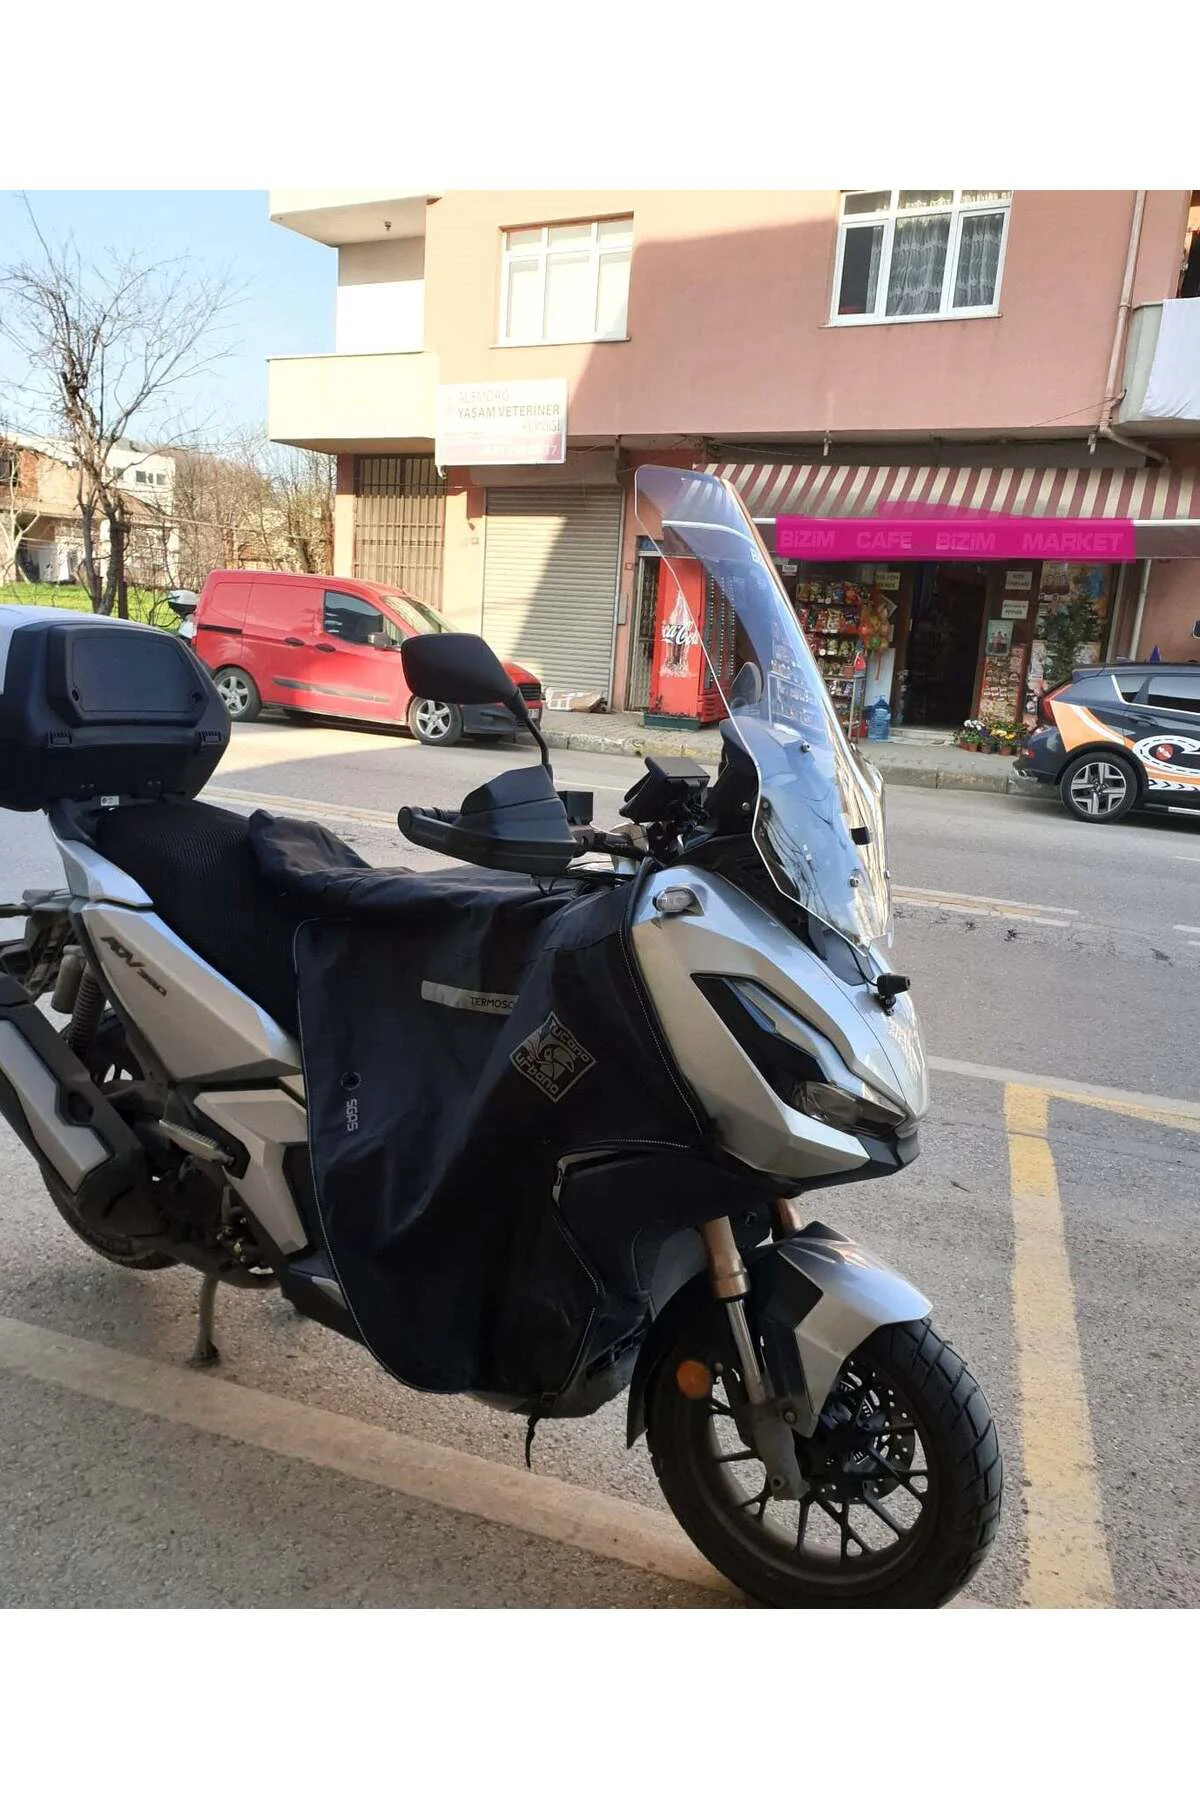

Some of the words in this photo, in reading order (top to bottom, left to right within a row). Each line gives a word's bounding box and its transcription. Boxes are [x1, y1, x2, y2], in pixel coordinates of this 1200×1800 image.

[458, 406, 495, 421] YAŞAM
[856, 531, 913, 549] CAFE
[1021, 532, 1124, 551] MARKET
[100, 937, 144, 968] ADV
